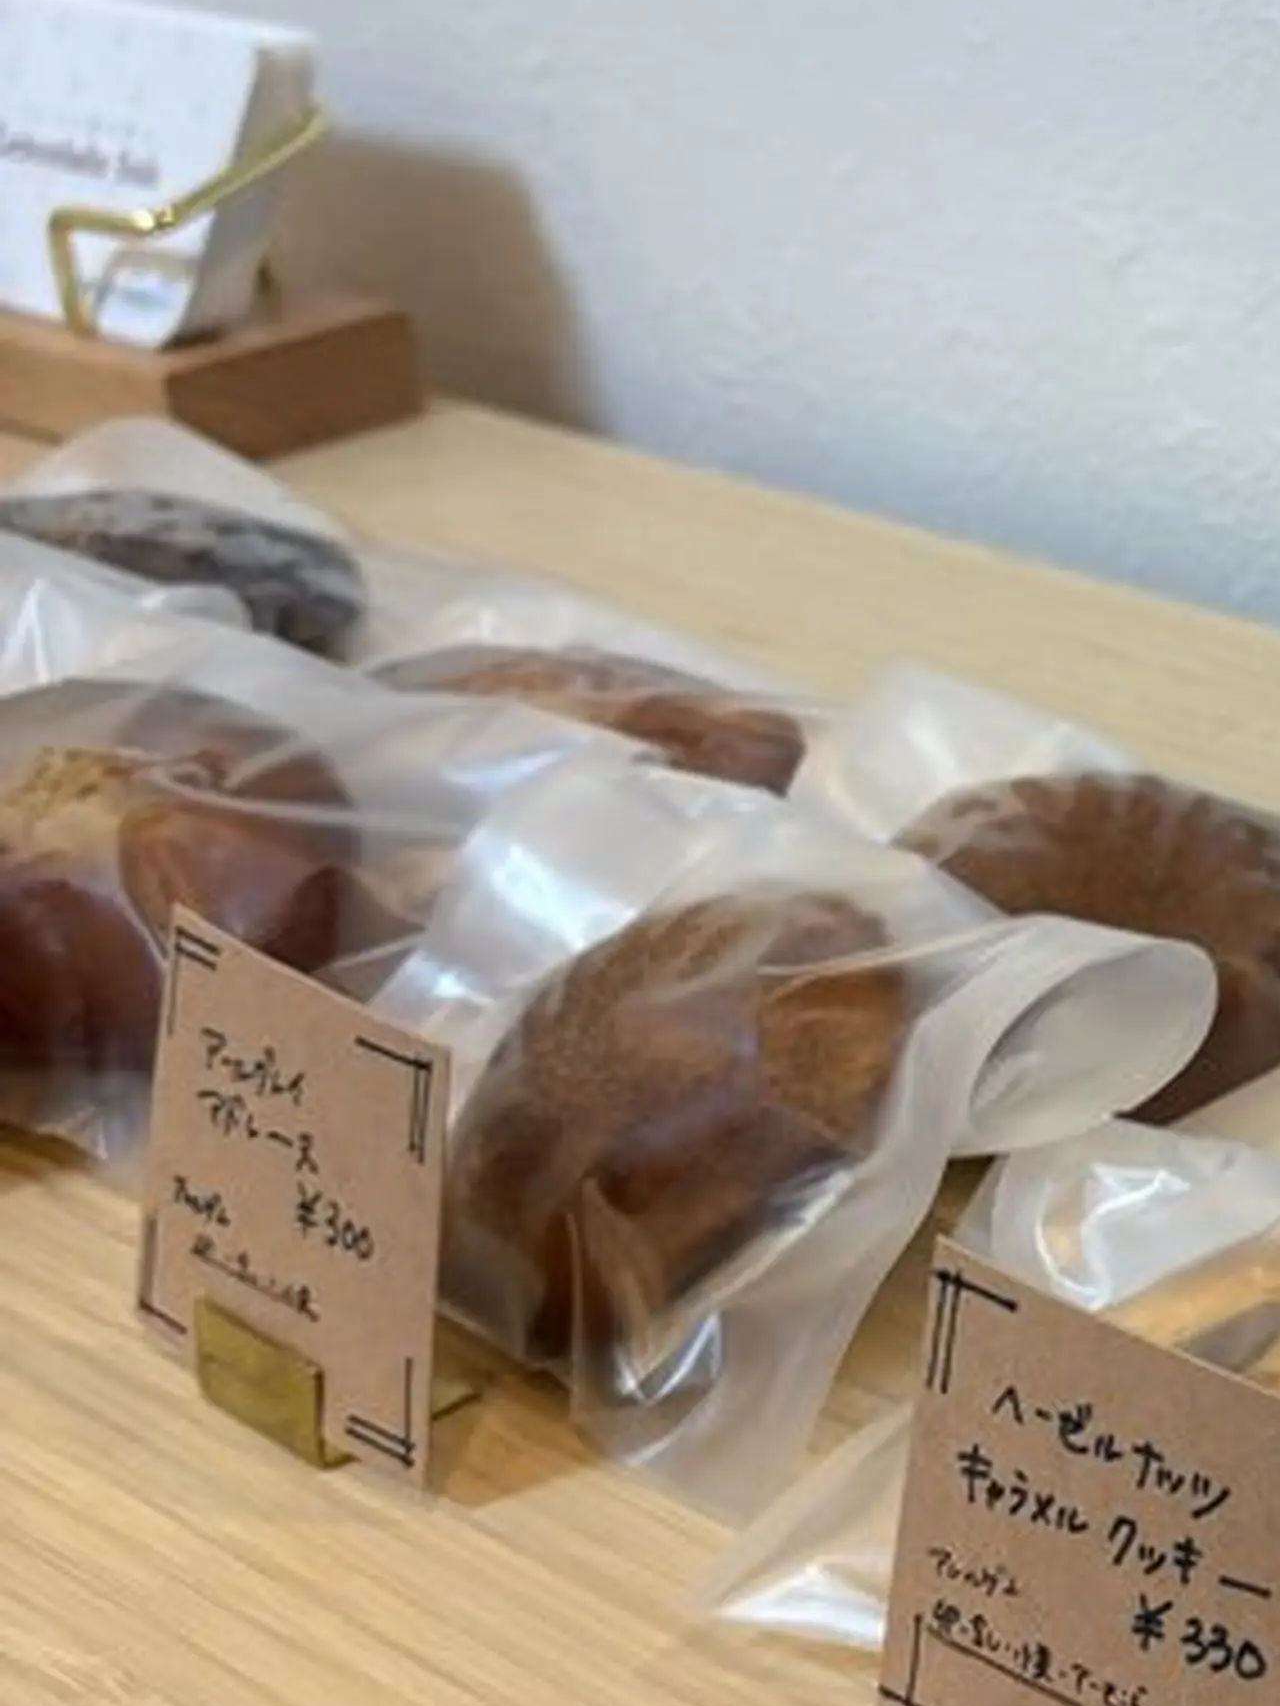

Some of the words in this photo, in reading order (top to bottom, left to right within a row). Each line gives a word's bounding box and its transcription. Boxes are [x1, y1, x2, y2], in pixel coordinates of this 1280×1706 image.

[297, 1180, 375, 1261] ¥300
[992, 1386, 1231, 1519] ヘーゼルナッツ
[957, 1443, 1089, 1533] キャラメル
[1107, 1515, 1272, 1599] クッキー
[1131, 1592, 1267, 1681] ¥330
